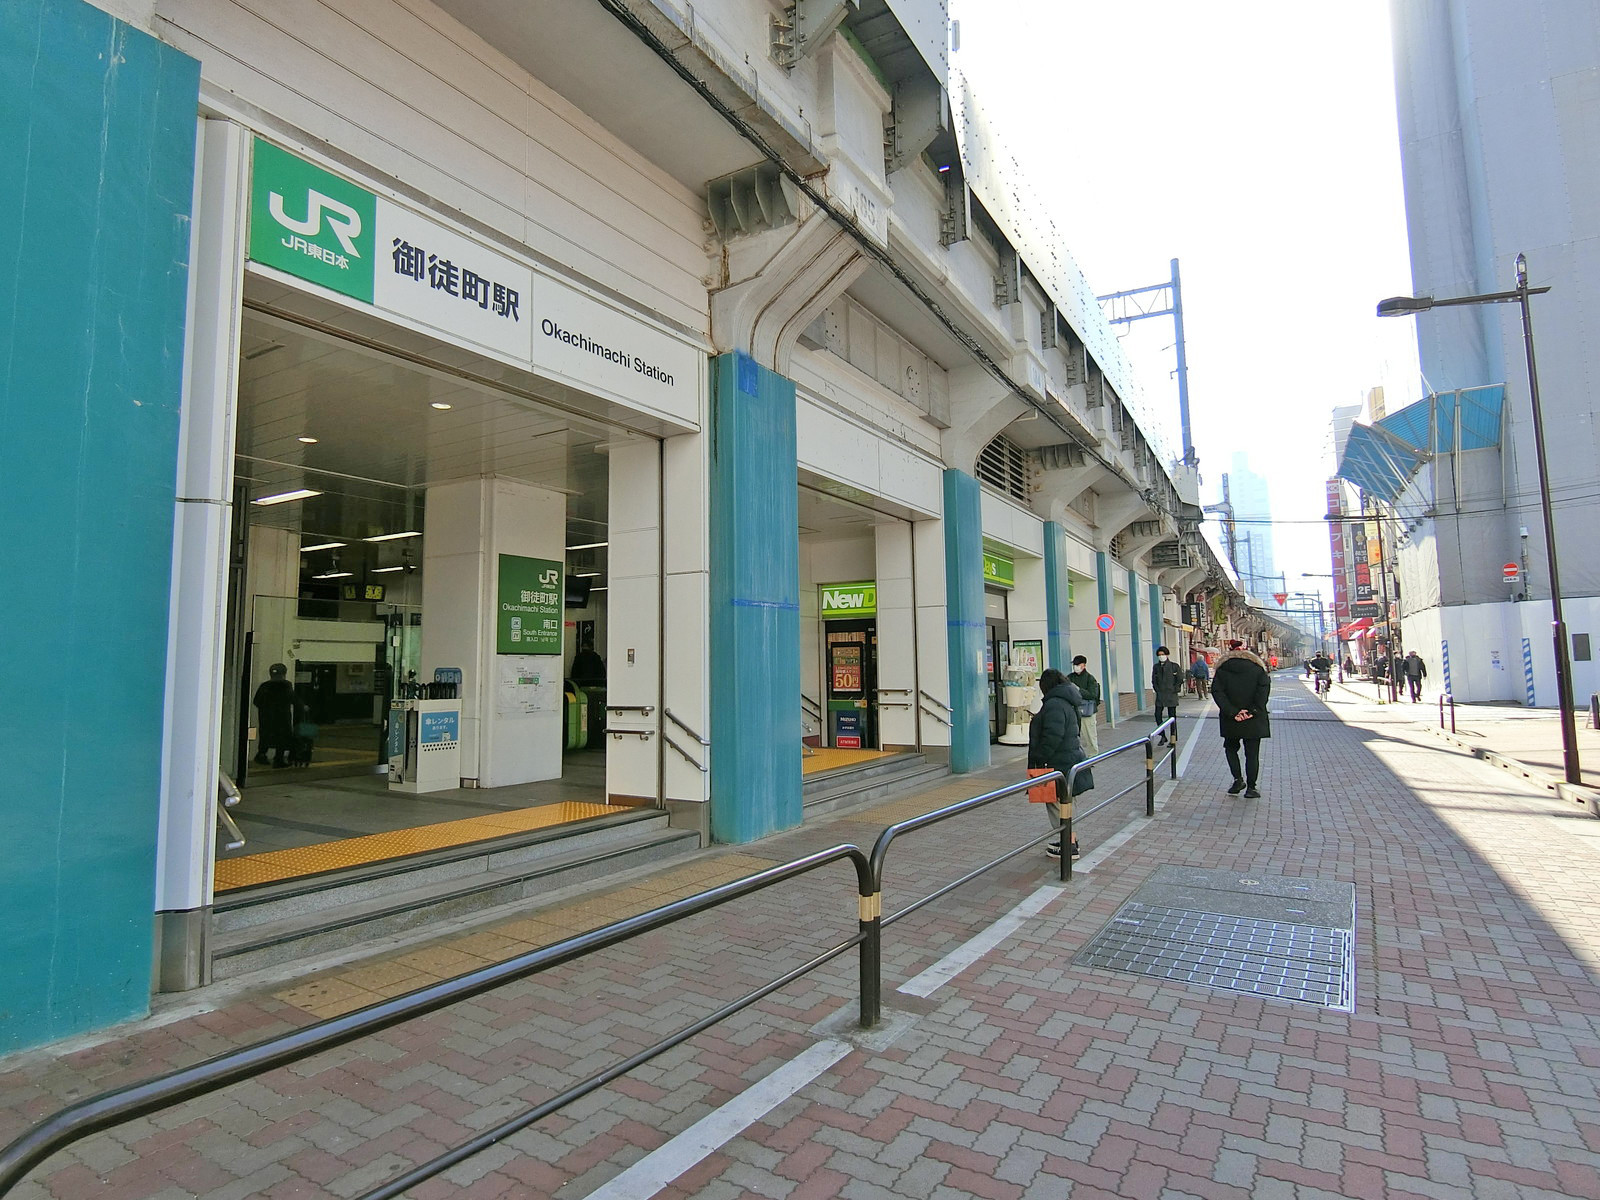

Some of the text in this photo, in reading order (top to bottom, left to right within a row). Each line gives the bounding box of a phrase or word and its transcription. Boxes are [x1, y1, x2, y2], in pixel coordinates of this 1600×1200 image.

[269, 188, 361, 258] JR
[281, 235, 349, 270] JR東日本
[392, 237, 519, 322] 御徒町駅
[541, 318, 674, 387] Okachimachi Station
[538, 569, 559, 585] JR
[520, 590, 558, 605] 御徒町駅
[1357, 586, 1371, 595] 2F
[502, 603, 559, 614] Okachimachi Station
[543, 619, 558, 629] 南口
